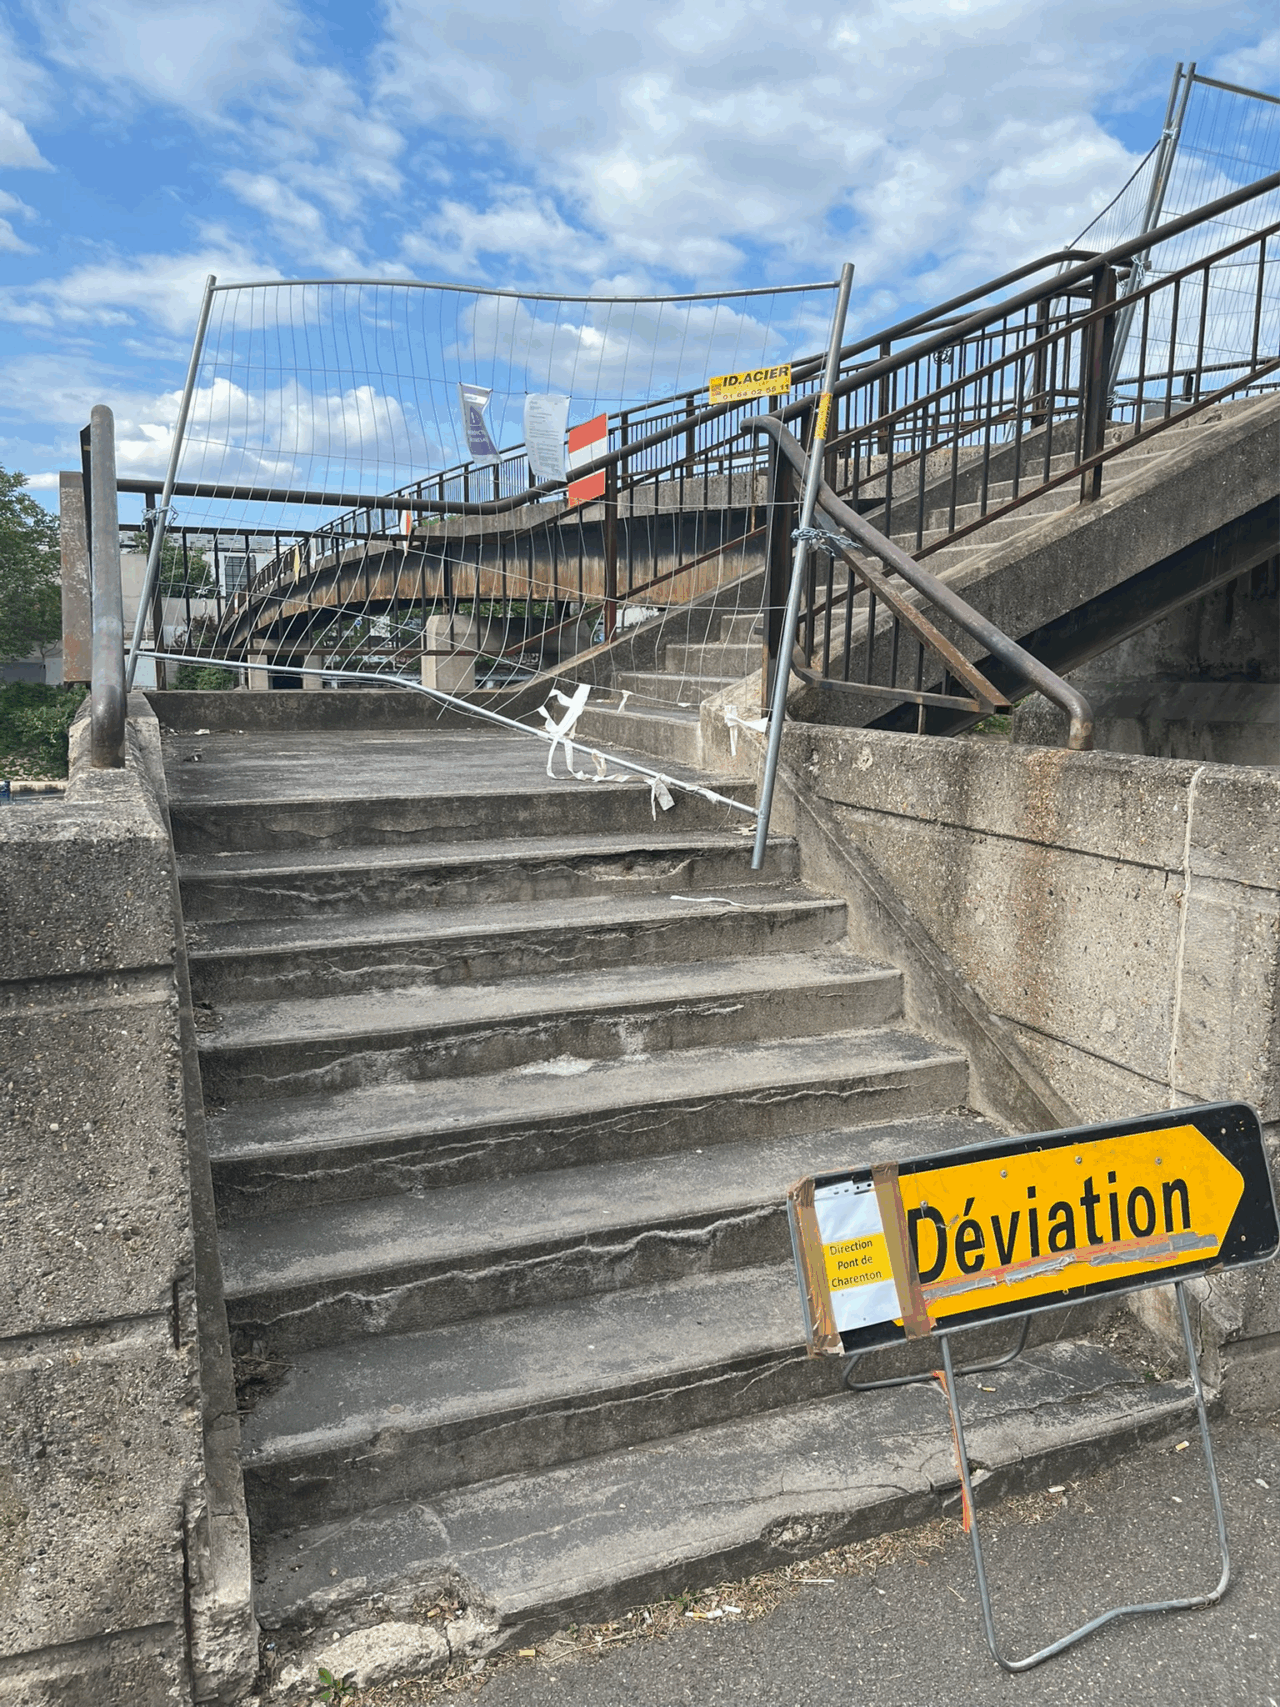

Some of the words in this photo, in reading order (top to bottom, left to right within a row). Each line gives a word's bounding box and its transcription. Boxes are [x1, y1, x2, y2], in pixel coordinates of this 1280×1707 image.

[723, 366, 789, 387] ID.ACIER
[907, 1170, 1192, 1285] Déviation
[829, 1239, 873, 1255] Direction
[837, 1258, 859, 1271] Pont
[861, 1255, 873, 1265] de
[831, 1270, 882, 1288] Charenton
